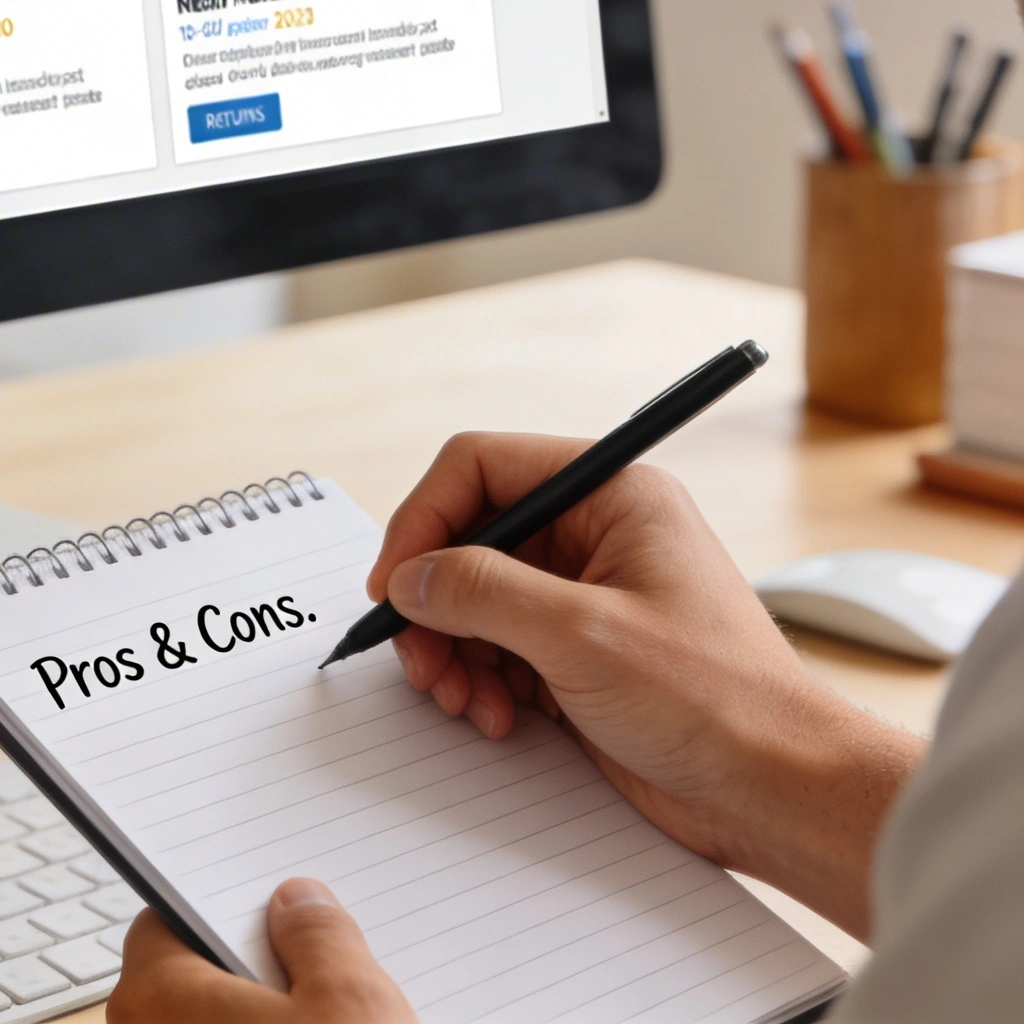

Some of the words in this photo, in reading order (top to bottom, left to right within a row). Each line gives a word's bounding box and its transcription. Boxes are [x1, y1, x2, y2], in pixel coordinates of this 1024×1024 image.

[274, 7, 314, 29] 2023
[30, 648, 144, 710] Pros
[150, 622, 198, 669] &
[197, 596, 317, 653] Cons.
